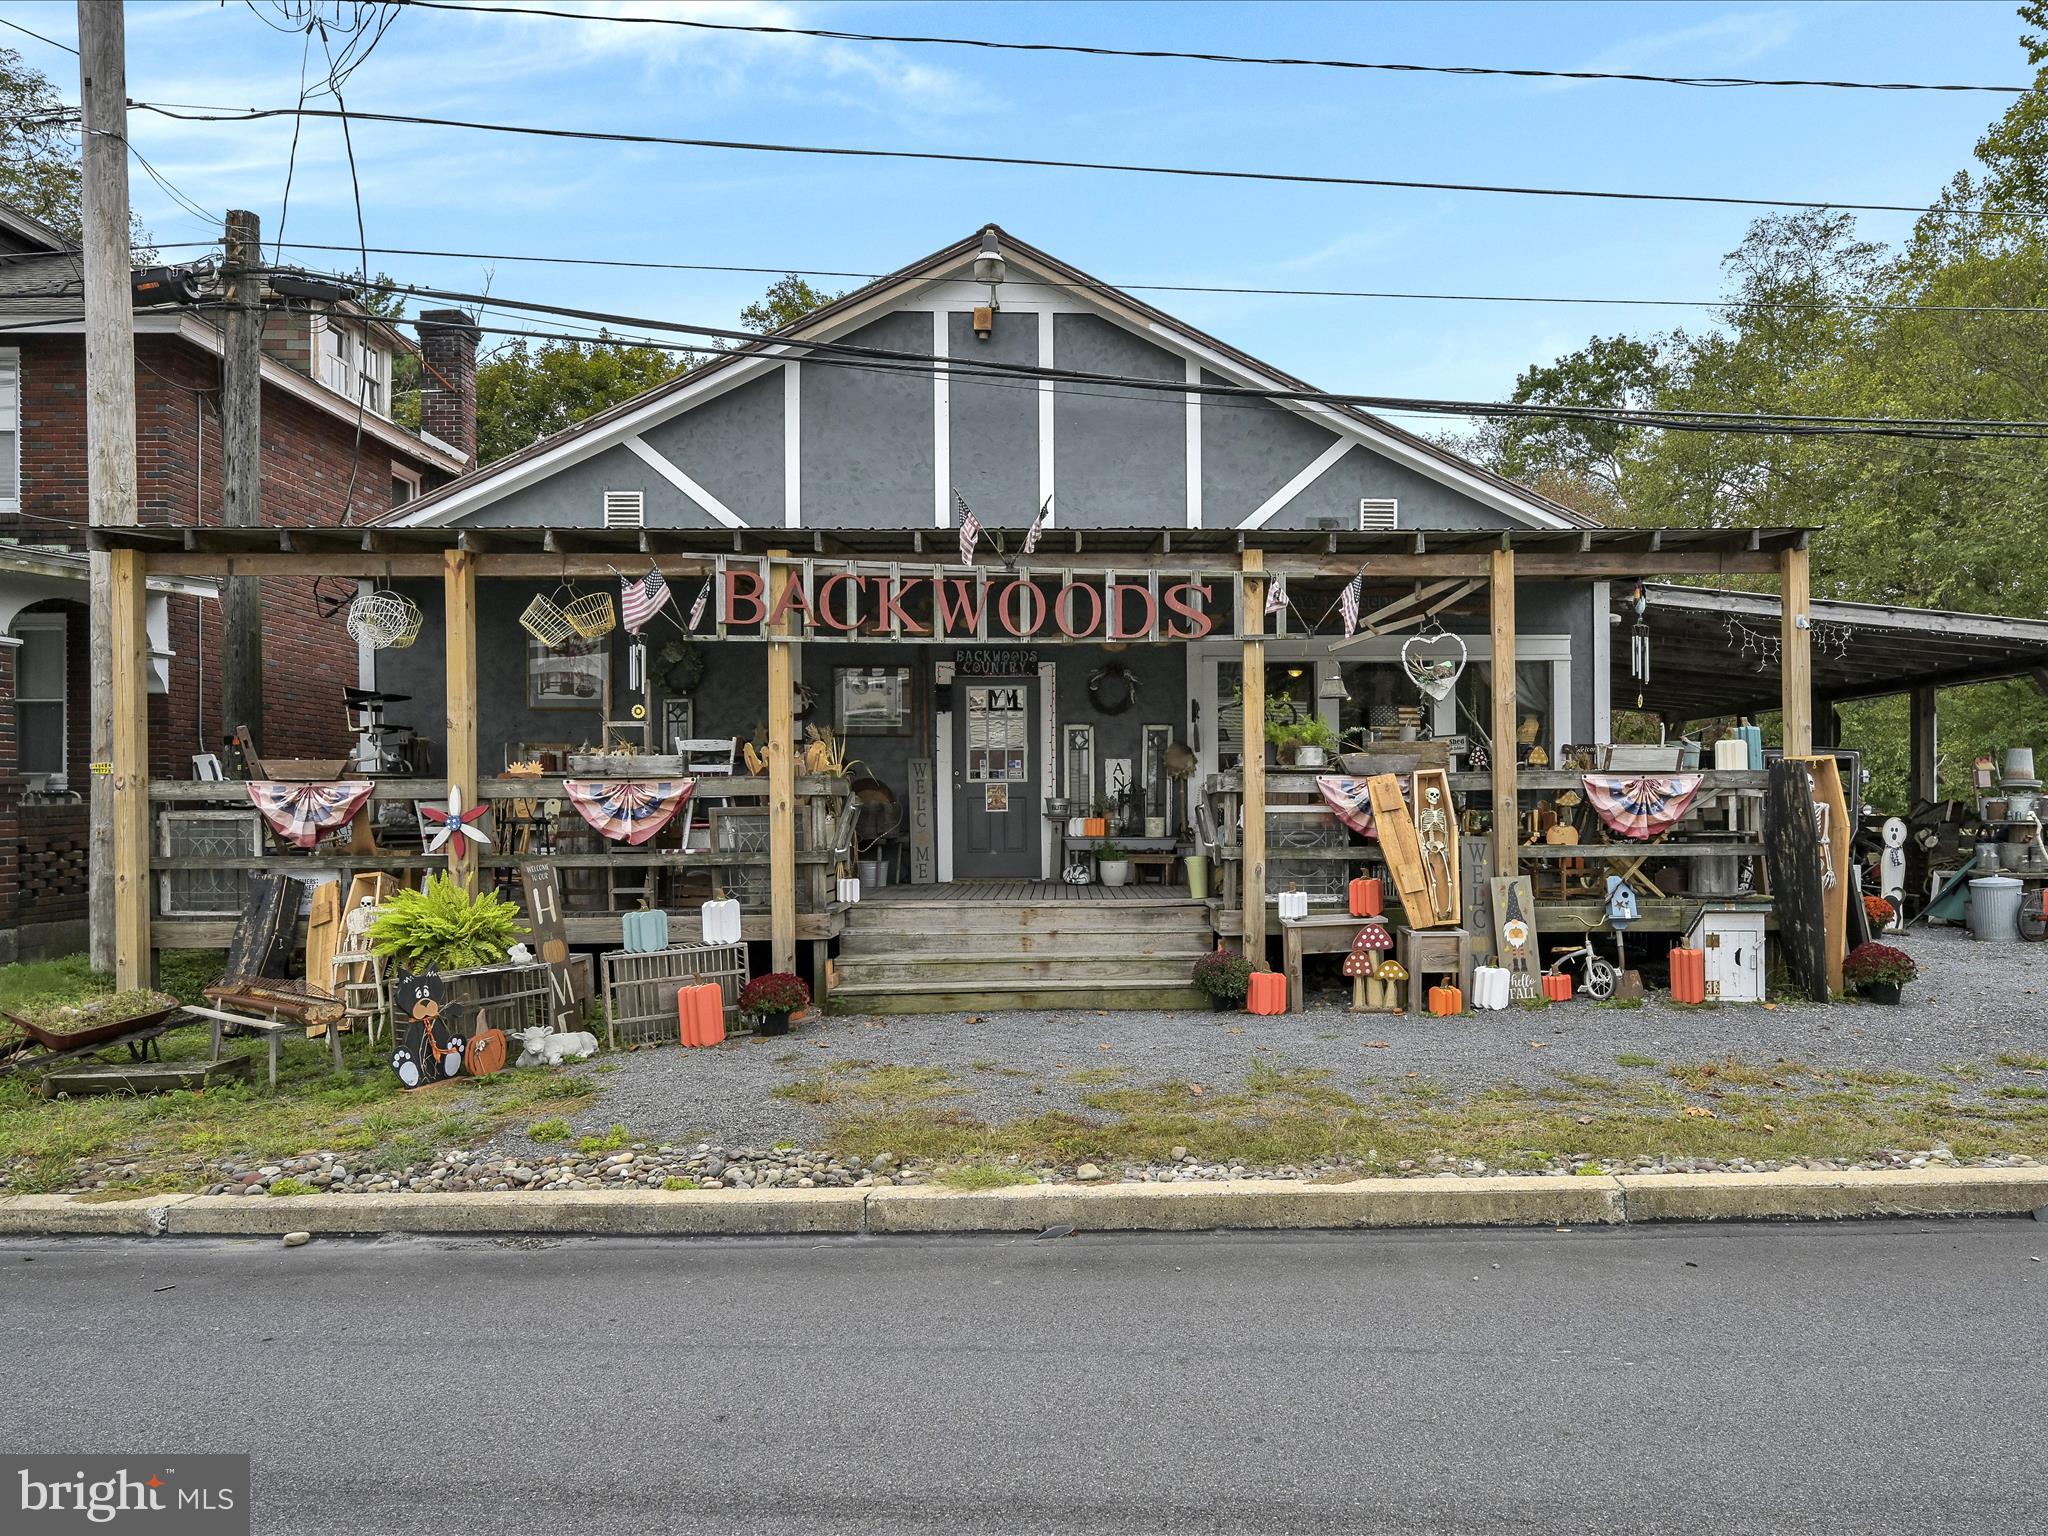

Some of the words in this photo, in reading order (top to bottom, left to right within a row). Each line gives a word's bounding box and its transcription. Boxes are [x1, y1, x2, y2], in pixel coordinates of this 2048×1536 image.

[720, 569, 1213, 638] BACKWOODS
[956, 650, 1038, 662] BACKWOODS
[963, 662, 1027, 673] COUNTRY
[912, 763, 929, 878] WELCME
[526, 863, 550, 874] WELCOME
[538, 873, 549, 881] OUR
[1510, 973, 1536, 988] hello
[1509, 987, 1537, 999] FALL
